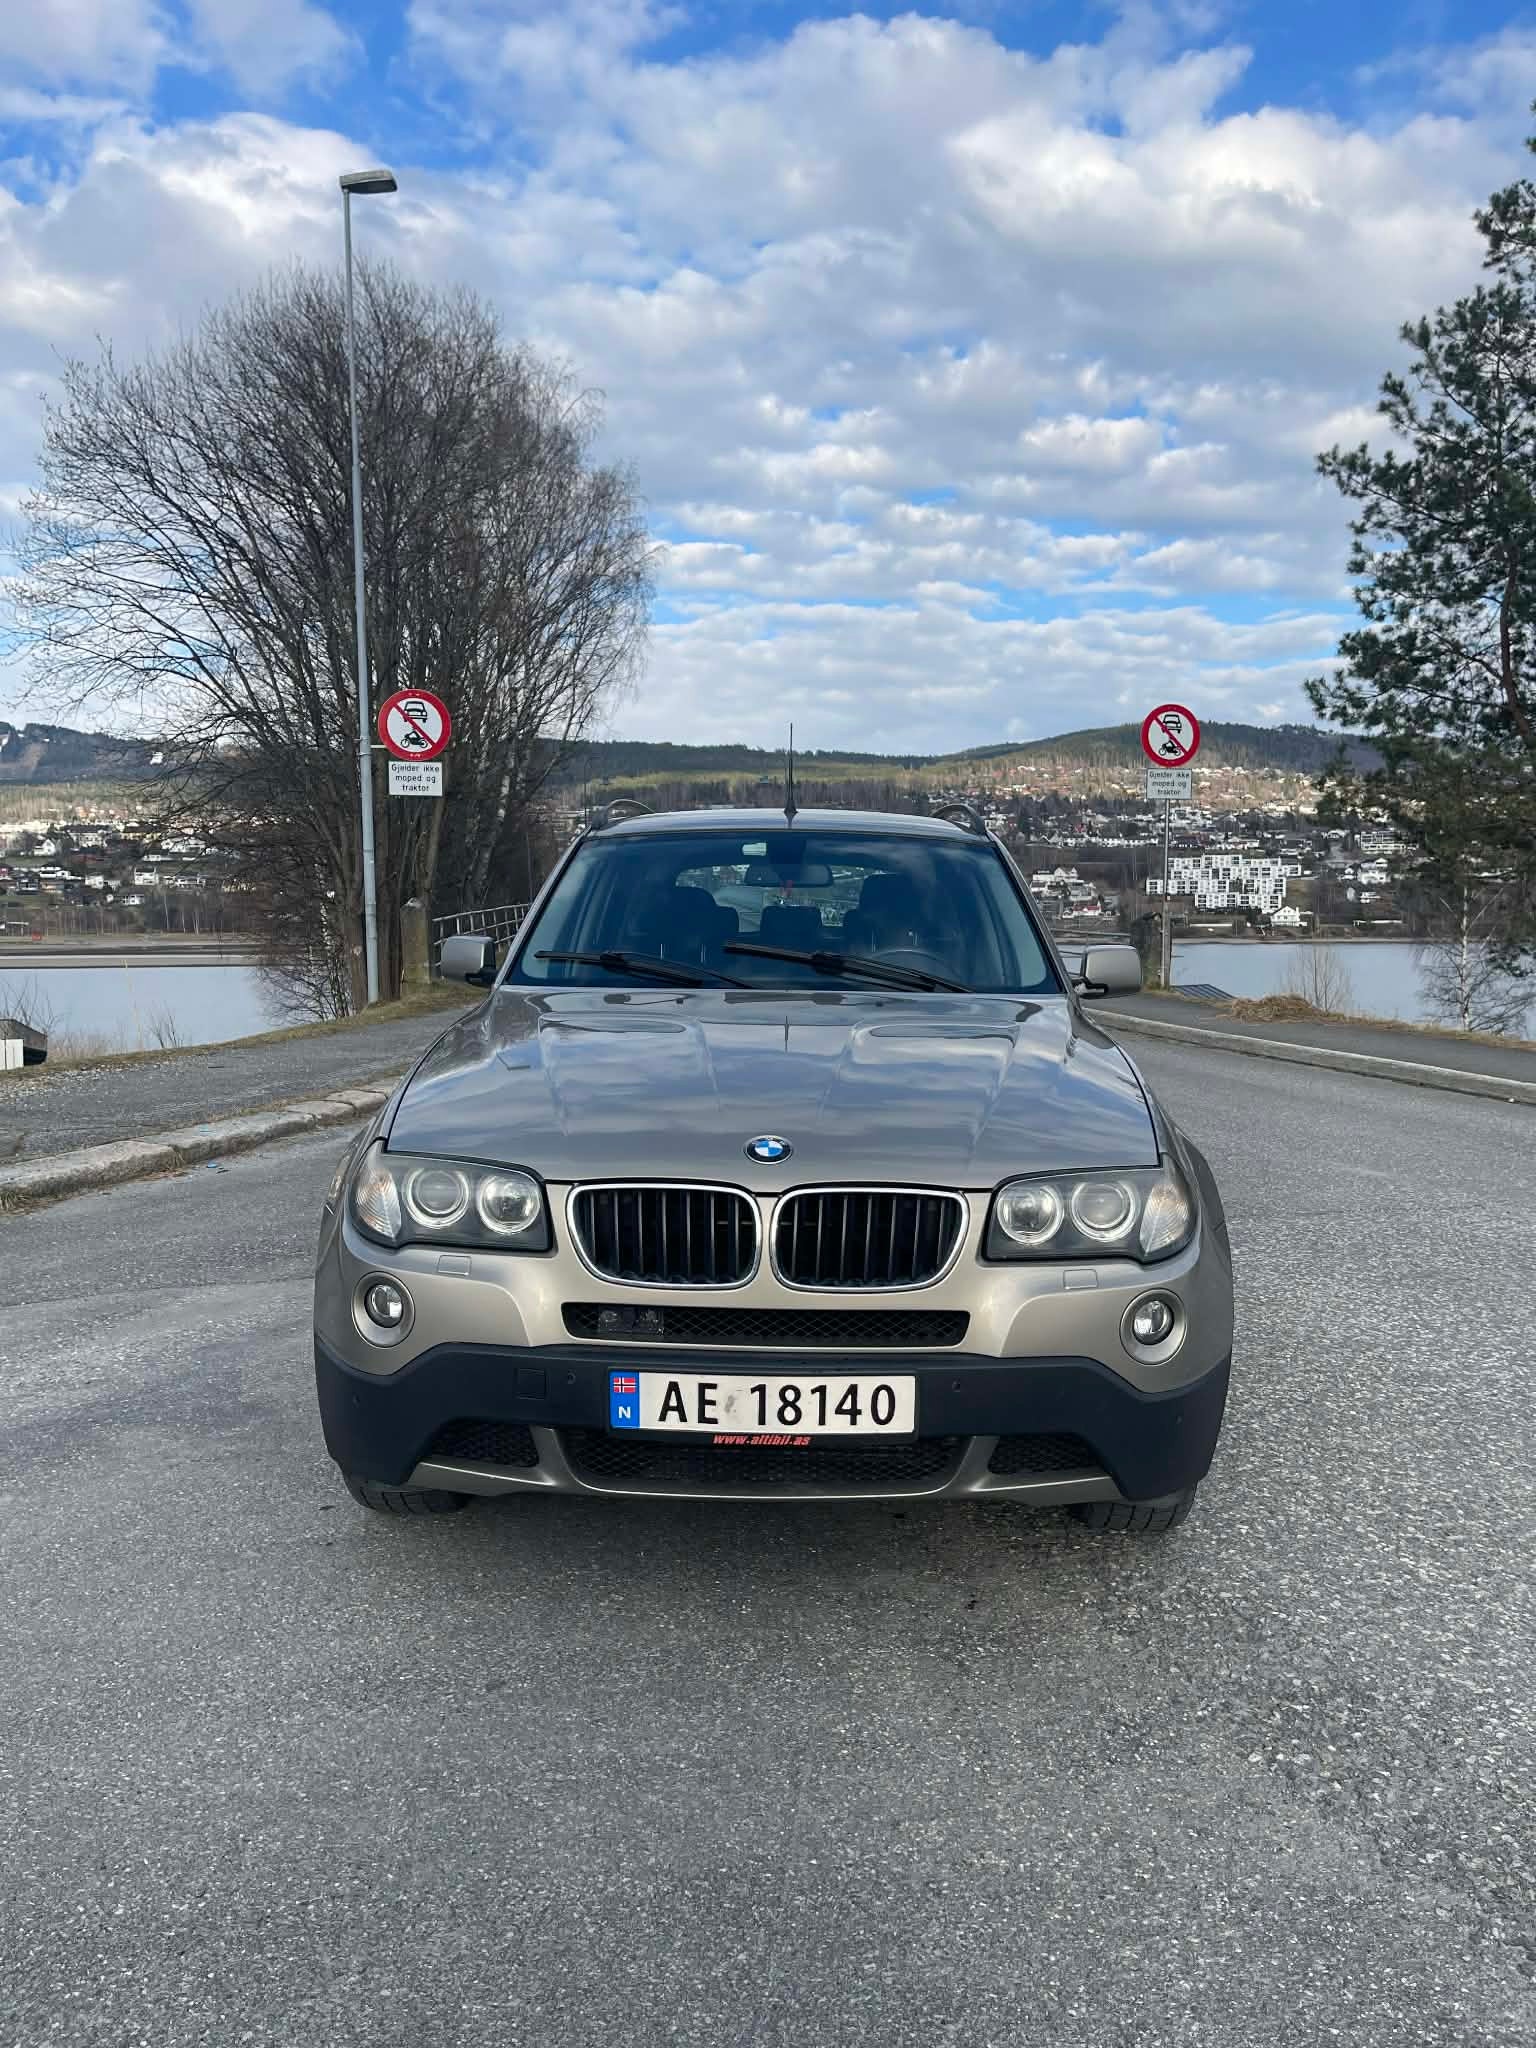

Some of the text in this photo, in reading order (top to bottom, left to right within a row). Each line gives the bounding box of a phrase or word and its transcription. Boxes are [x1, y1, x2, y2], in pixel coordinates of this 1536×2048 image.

[402, 784, 429, 792] traktor
[658, 1381, 896, 1426] AE 18140
[618, 1406, 631, 1419] N
[713, 1434, 811, 1445] www.altibil.as
